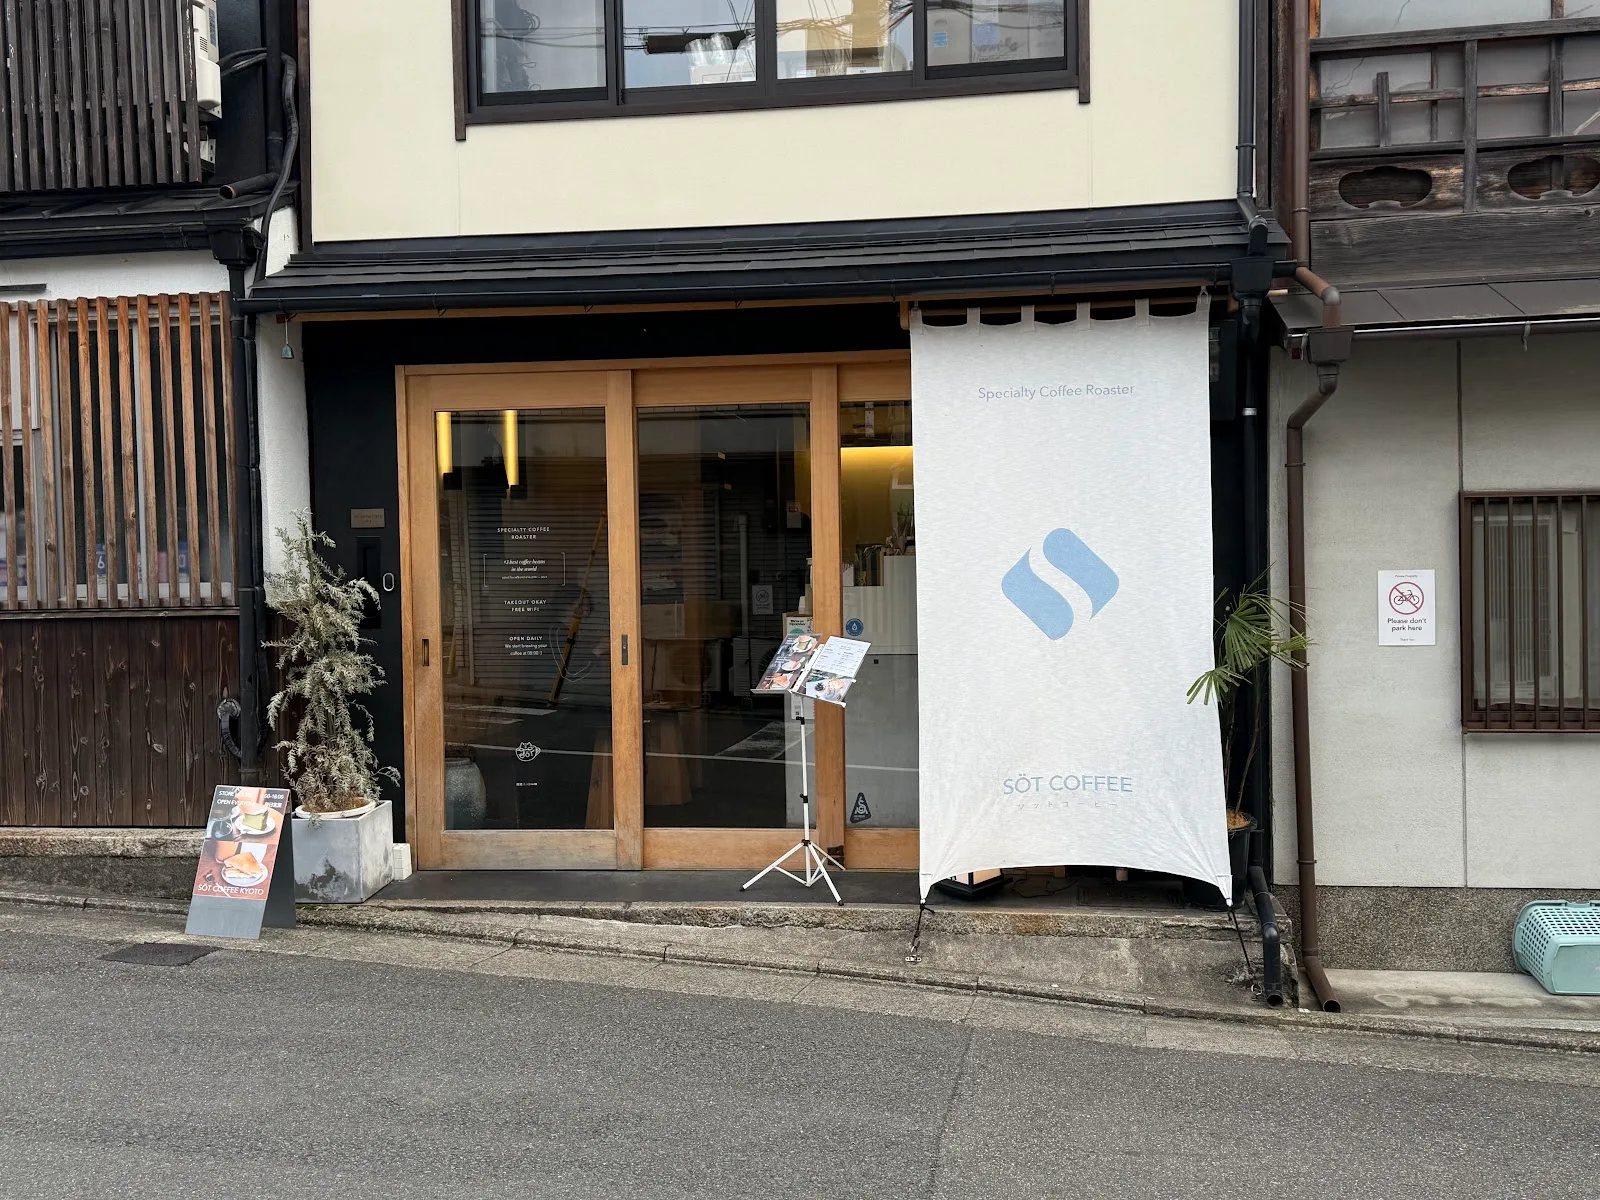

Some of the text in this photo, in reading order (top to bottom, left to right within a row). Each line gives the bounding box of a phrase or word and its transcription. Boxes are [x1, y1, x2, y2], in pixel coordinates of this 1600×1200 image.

[978, 383, 1135, 401] Specialty Coffee Roaster
[1391, 625, 1406, 633] park
[1002, 772, 1133, 795] SÖT COFFEE
[197, 883, 265, 896] SÖT COFFEE KYOTO
